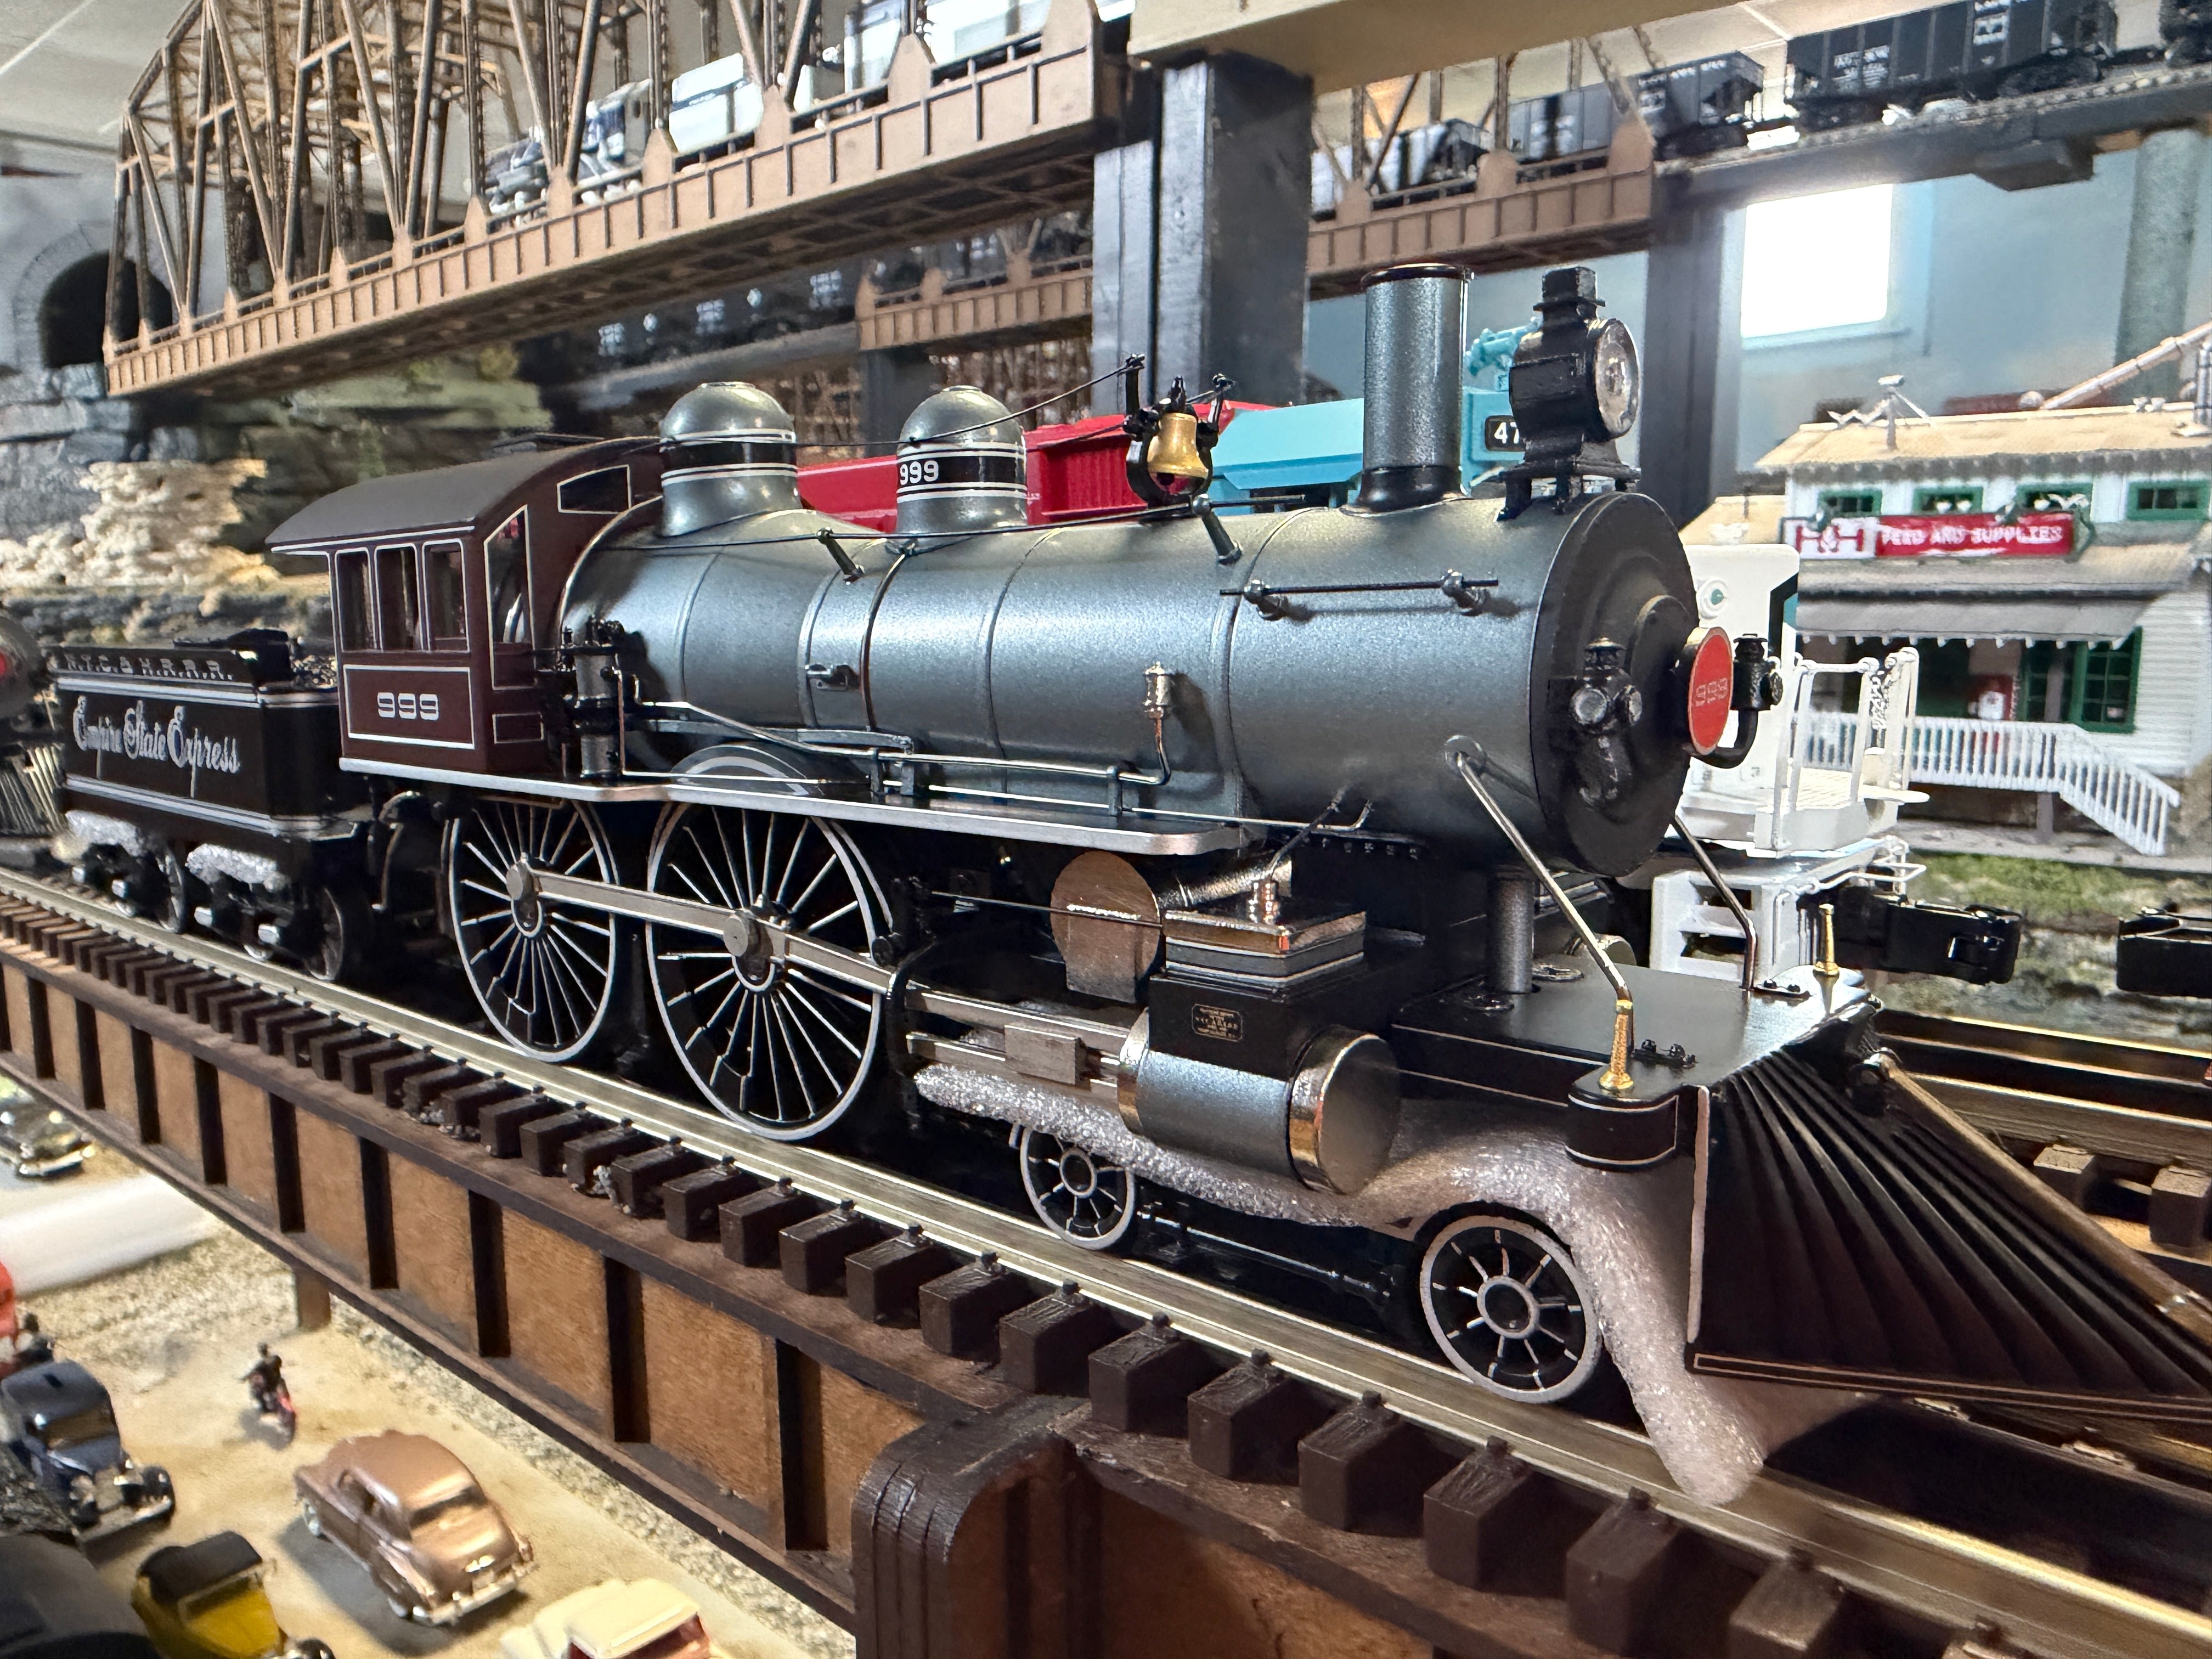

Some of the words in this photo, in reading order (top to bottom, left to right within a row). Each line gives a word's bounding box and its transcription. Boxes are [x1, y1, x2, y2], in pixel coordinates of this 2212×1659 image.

[899, 460, 939, 486] 999
[1930, 526, 1965, 545] AND
[1971, 525, 2063, 545] SUPPLIES
[377, 692, 439, 721] 999
[1695, 677, 1729, 707] 999
[122, 699, 167, 760] State
[167, 706, 241, 799] Express
